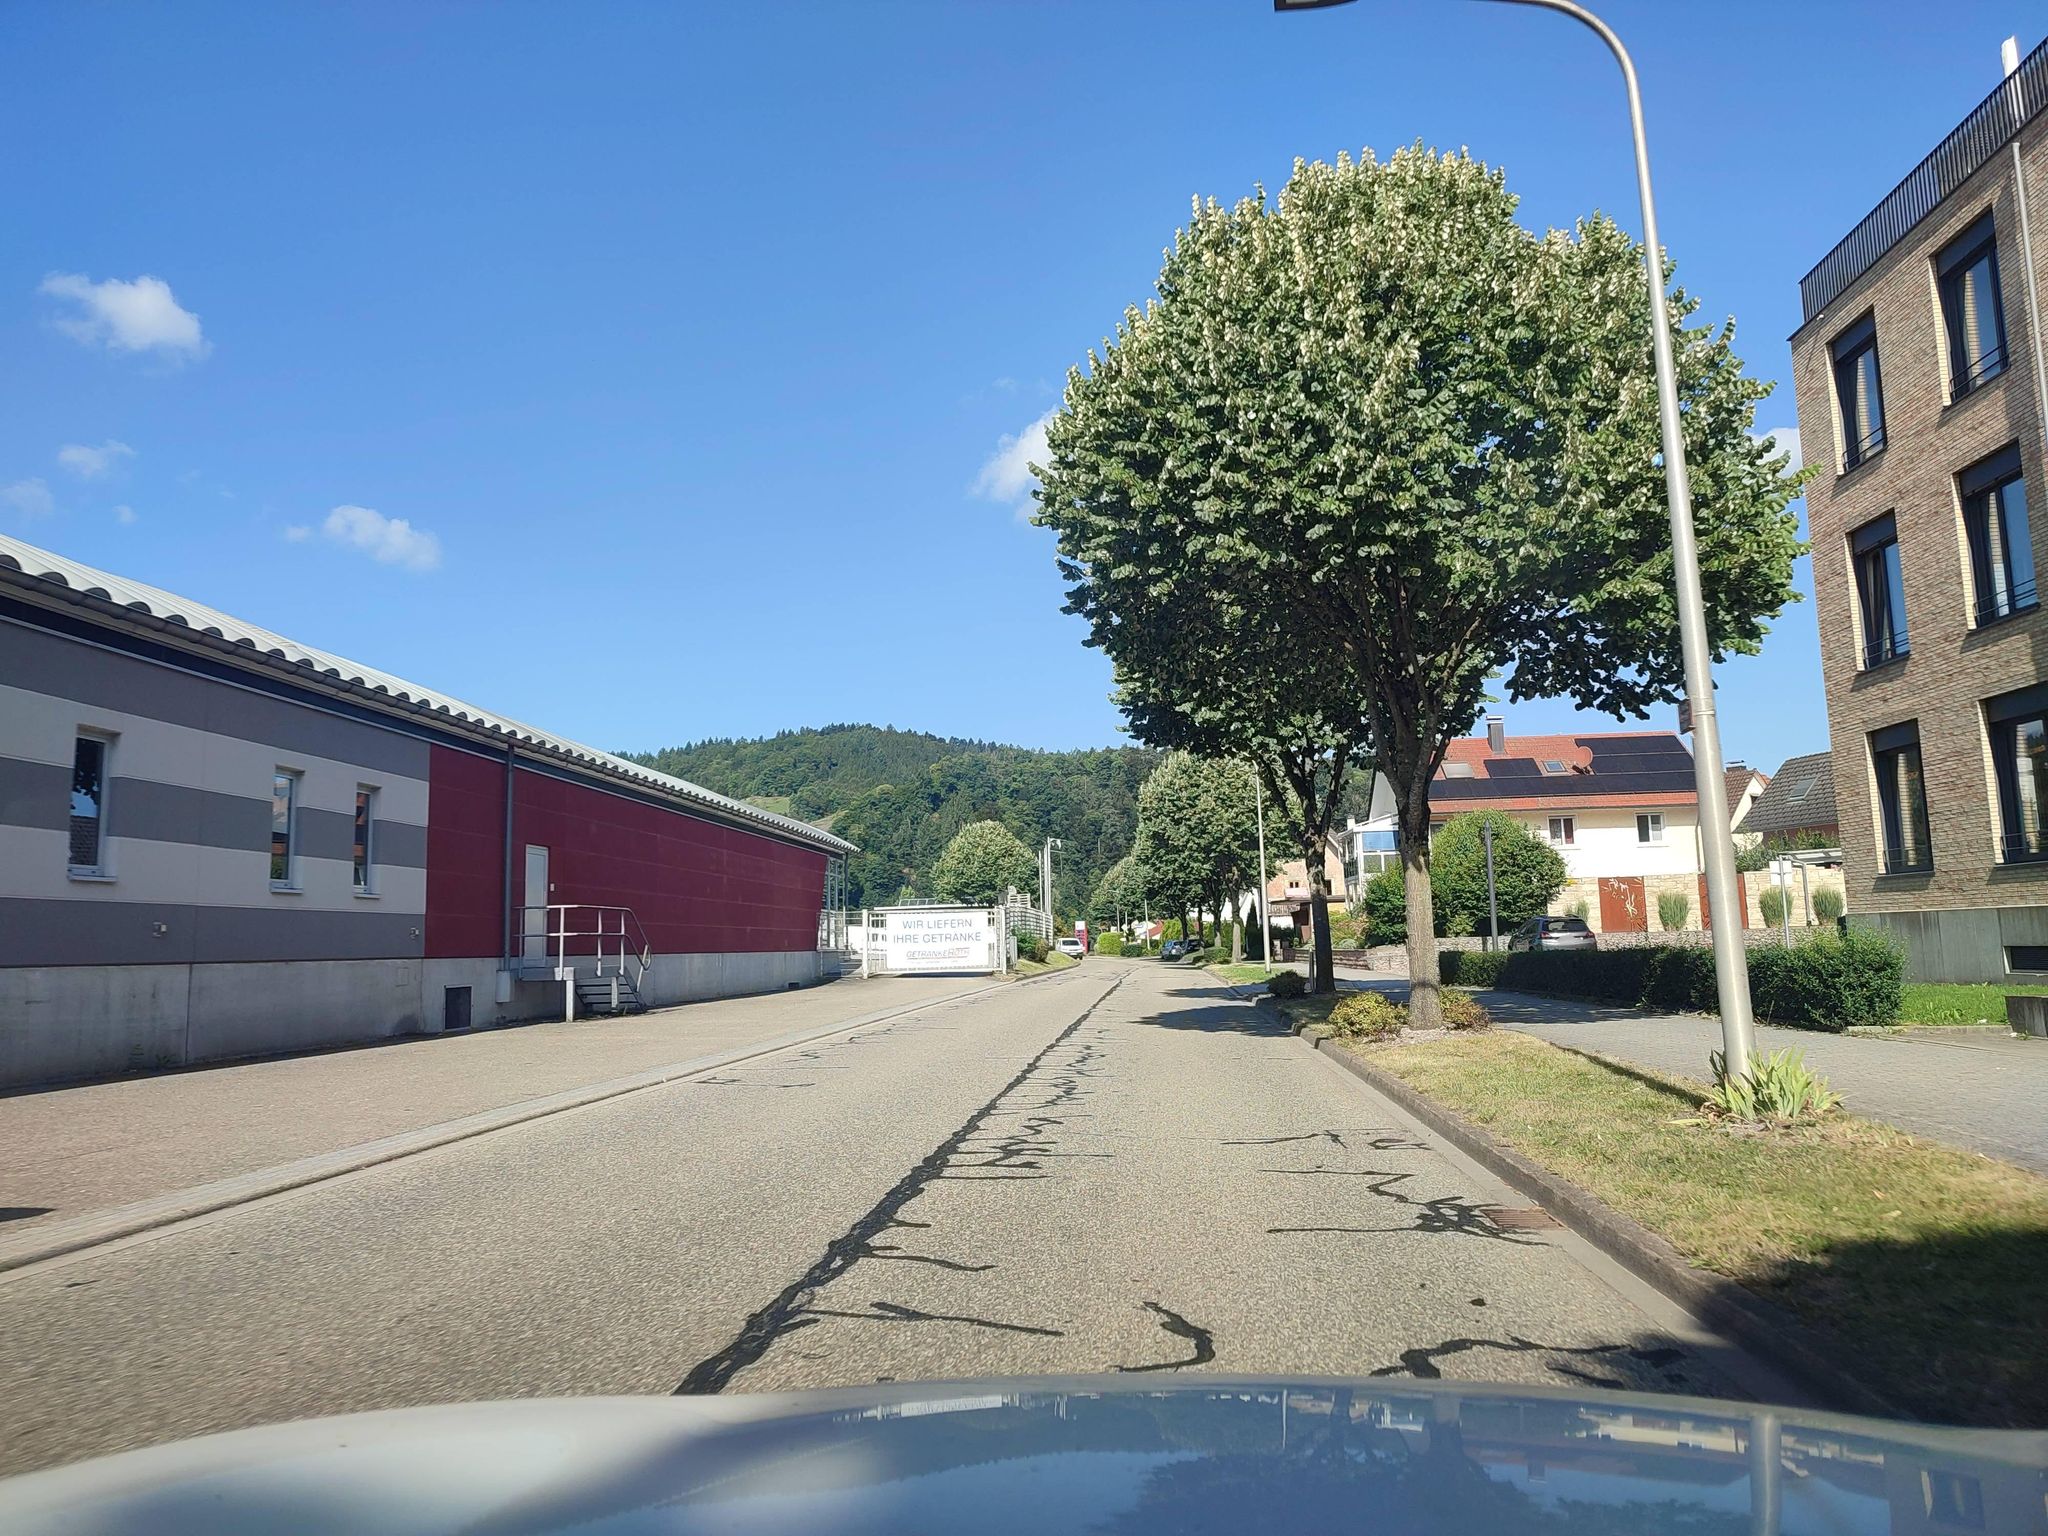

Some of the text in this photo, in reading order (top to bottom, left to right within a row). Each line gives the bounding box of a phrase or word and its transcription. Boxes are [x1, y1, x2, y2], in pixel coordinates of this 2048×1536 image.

[902, 919, 972, 929] WIR LIEFERN
[893, 934, 919, 943] IHRE
